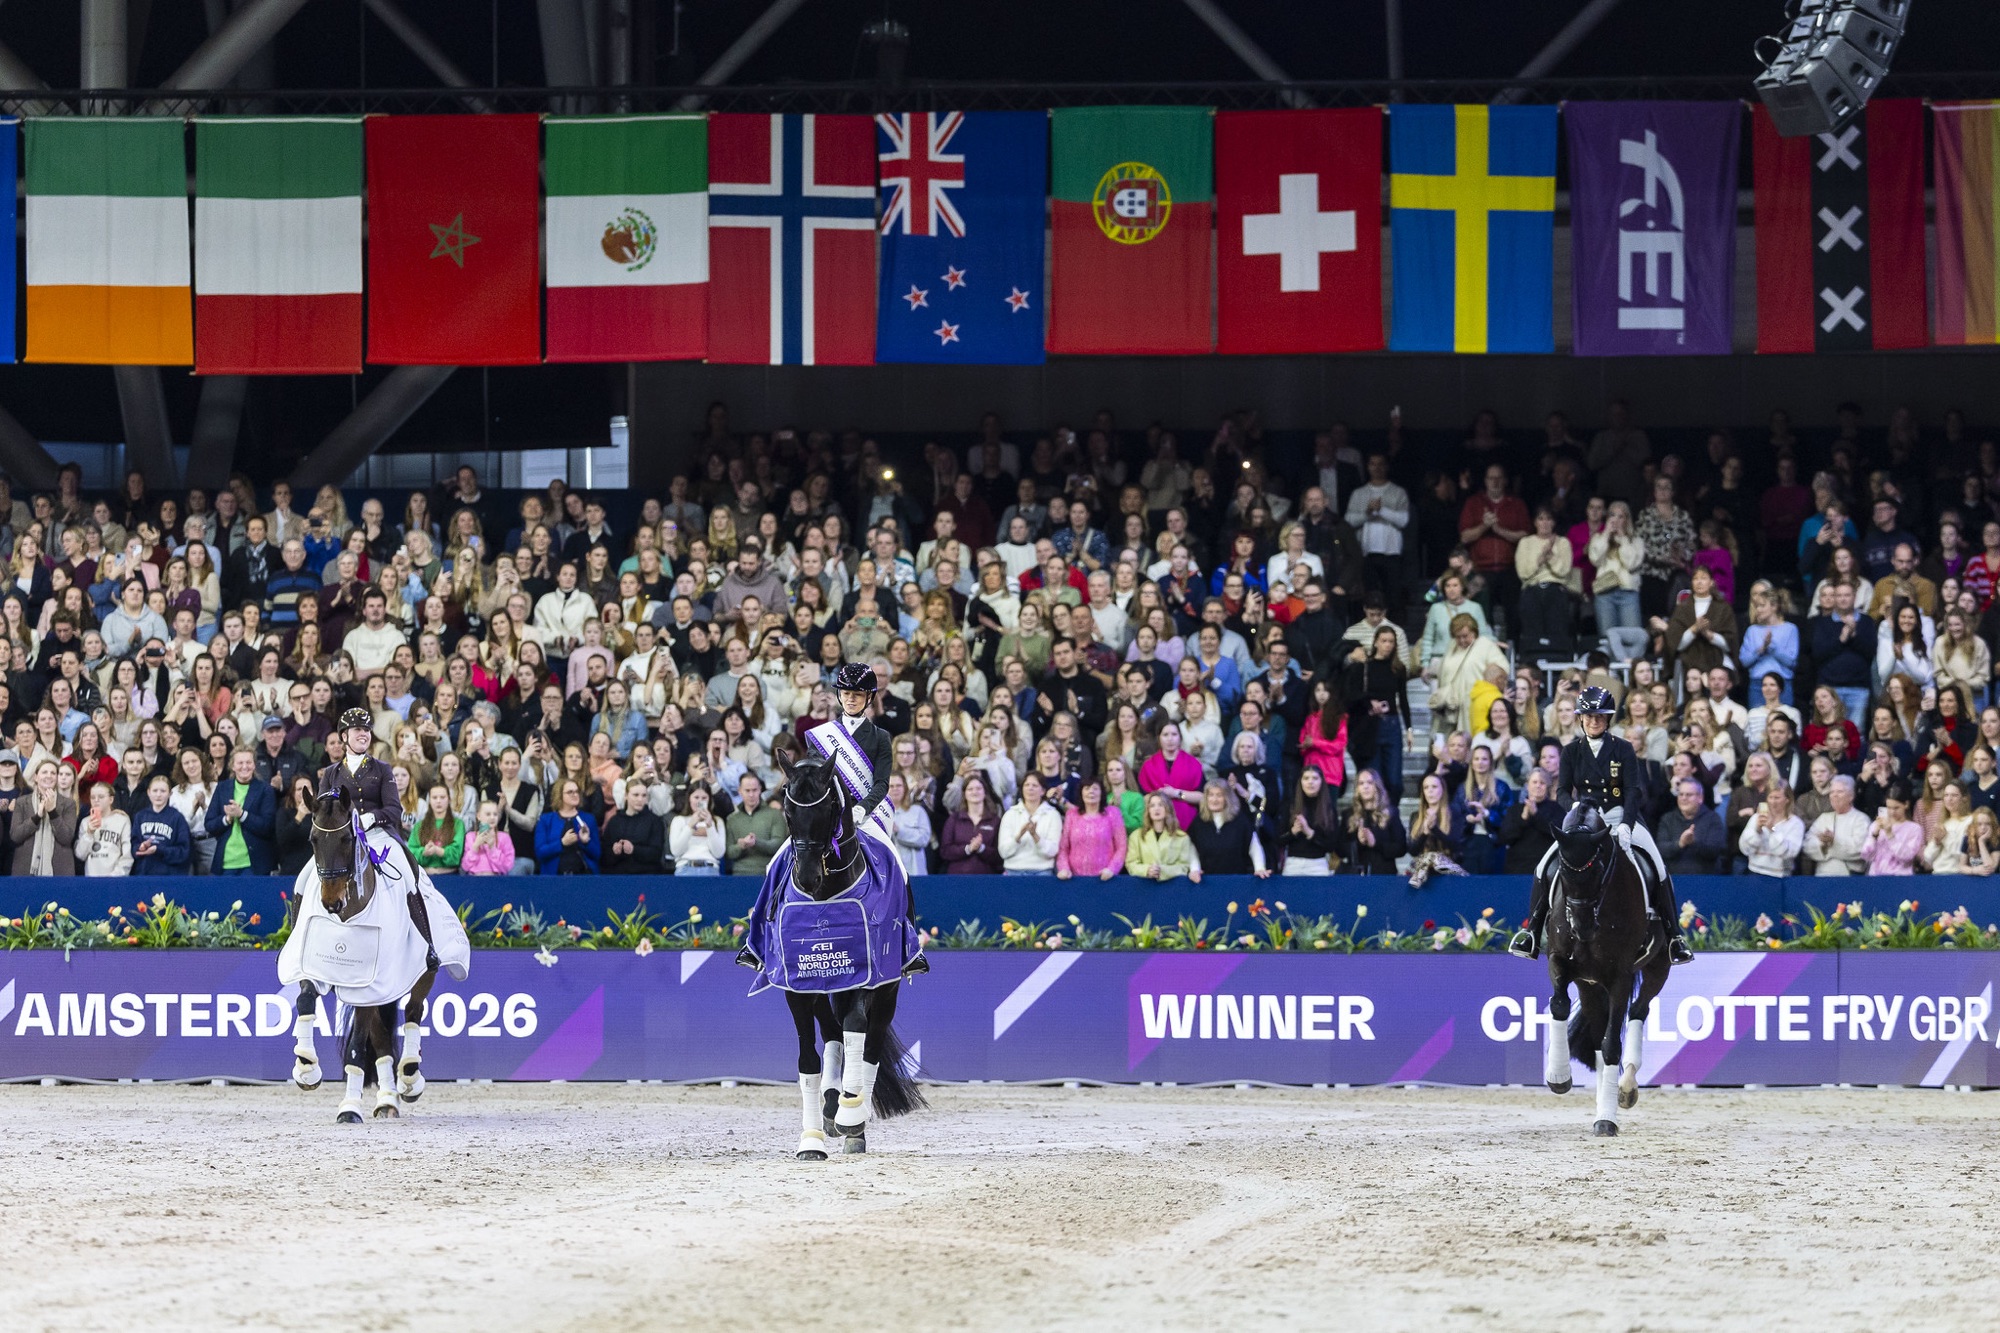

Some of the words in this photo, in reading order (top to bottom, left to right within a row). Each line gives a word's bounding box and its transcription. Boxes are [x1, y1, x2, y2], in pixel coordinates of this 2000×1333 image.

[1618, 129, 1685, 330] FEI
[826, 734, 842, 749] FEI
[837, 747, 867, 782] DRESSAGE
[878, 804, 891, 819] CUP
[153, 822, 173, 840] YORK
[811, 942, 834, 952] FEI
[797, 961, 830, 971] WORLD
[831, 958, 853, 968] CUP
[798, 951, 849, 963] DRESSAGE
[796, 966, 855, 978] AMSTERDAM
[14, 992, 354, 1037] AMSTERDA
[1141, 994, 1376, 1041] WINNER
[1480, 995, 1812, 1042] CHLOTTE
[1822, 995, 1904, 1041] FRY
[1908, 995, 1989, 1042] GBR
